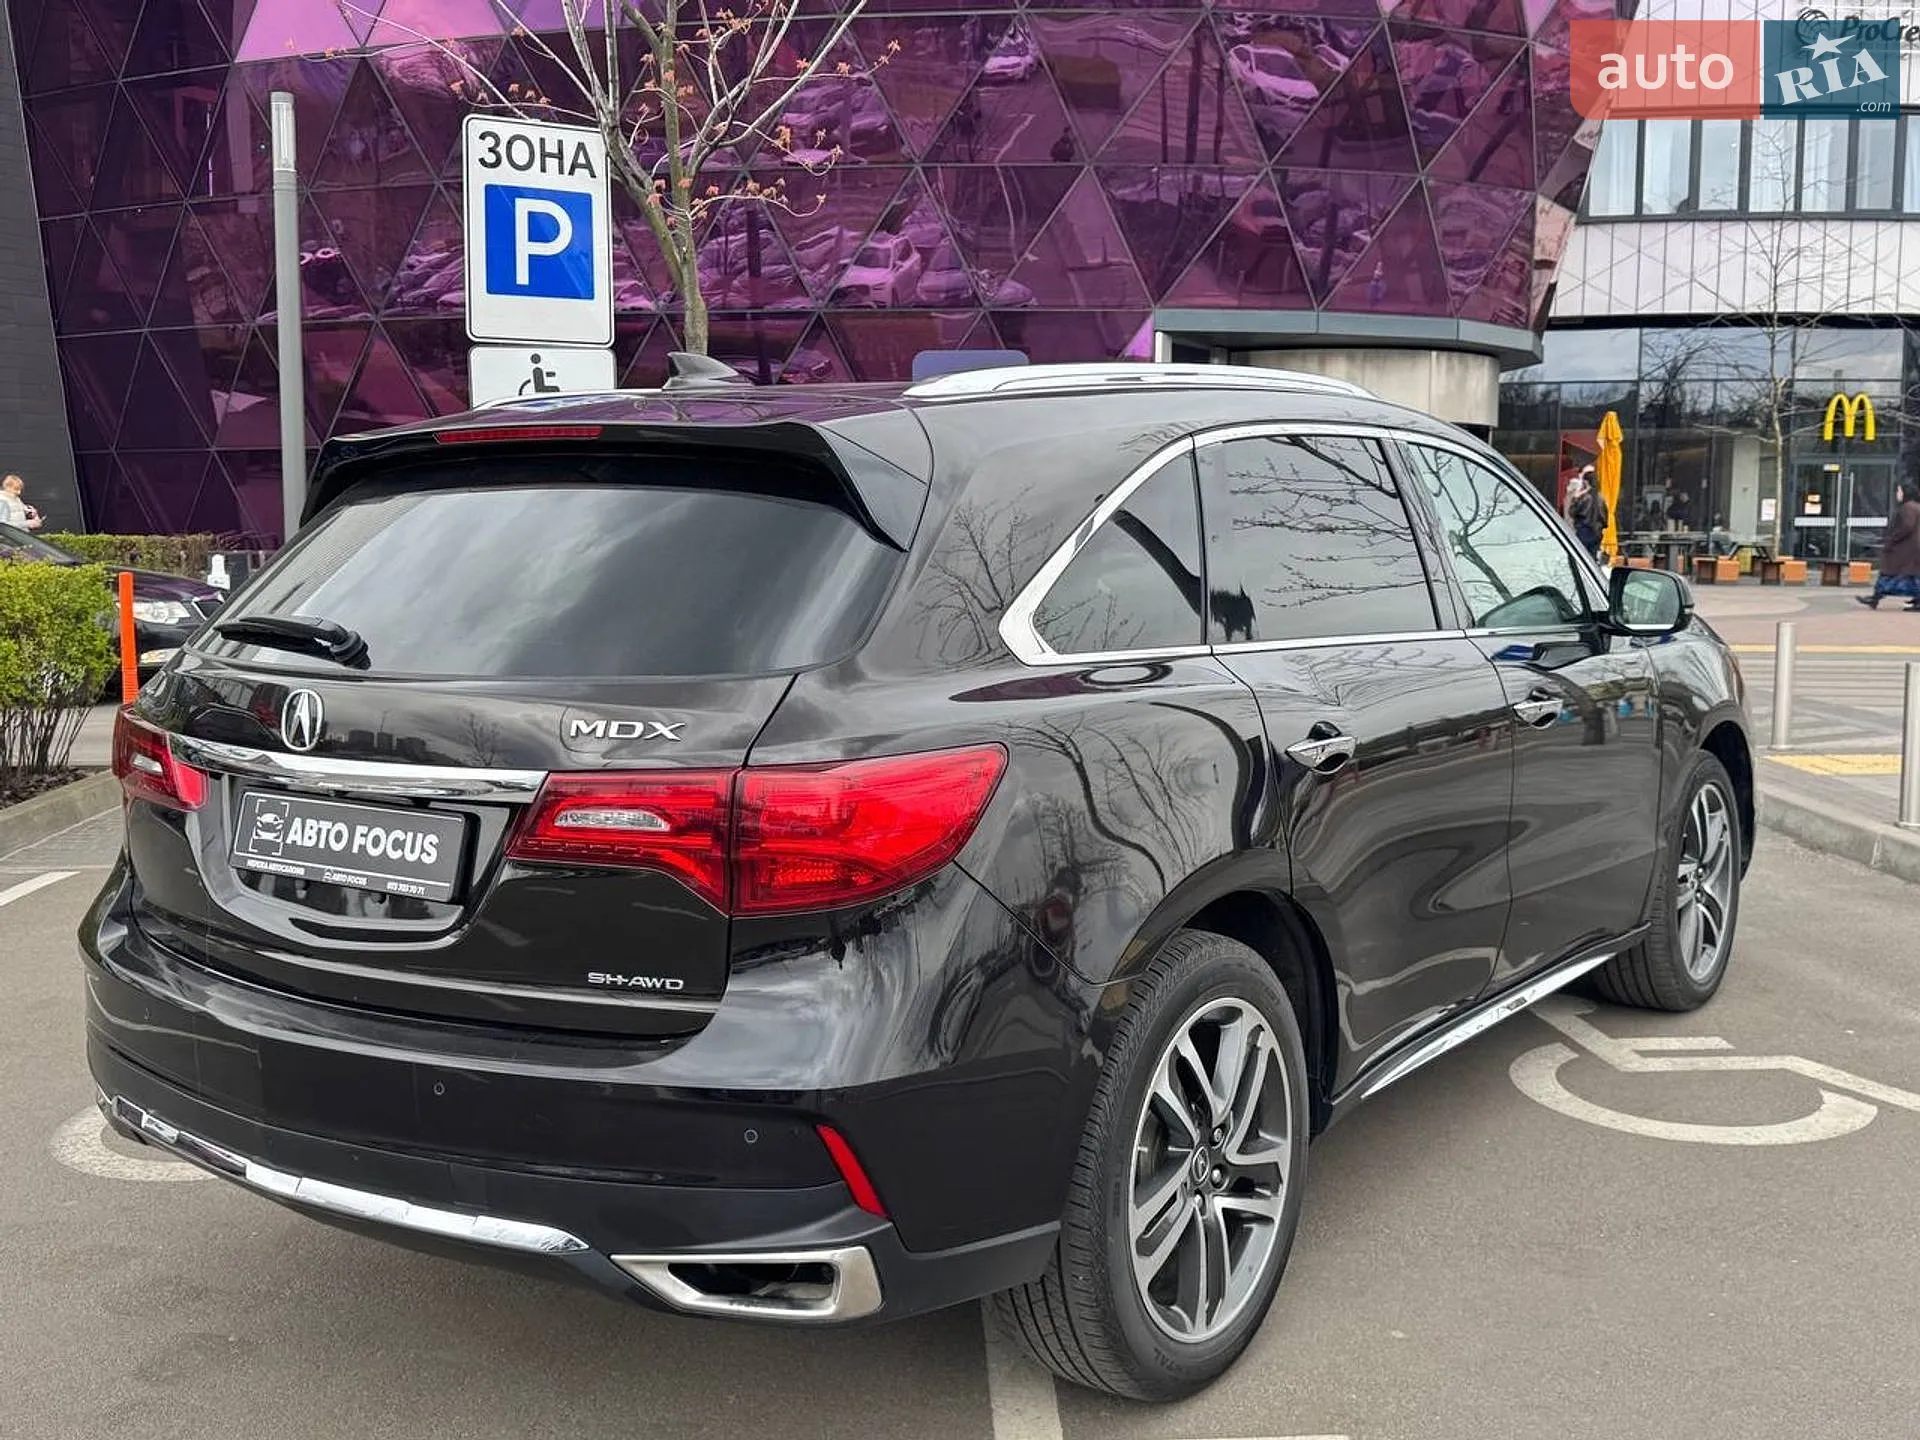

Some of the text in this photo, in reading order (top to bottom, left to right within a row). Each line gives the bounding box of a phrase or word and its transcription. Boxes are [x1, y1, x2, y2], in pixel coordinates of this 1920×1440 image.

[478, 131, 597, 178] ЗОНА
[514, 197, 573, 285] P
[569, 719, 685, 741] MDX
[286, 817, 440, 864] АВТО FOCUS
[588, 972, 684, 990] SH-AWD
